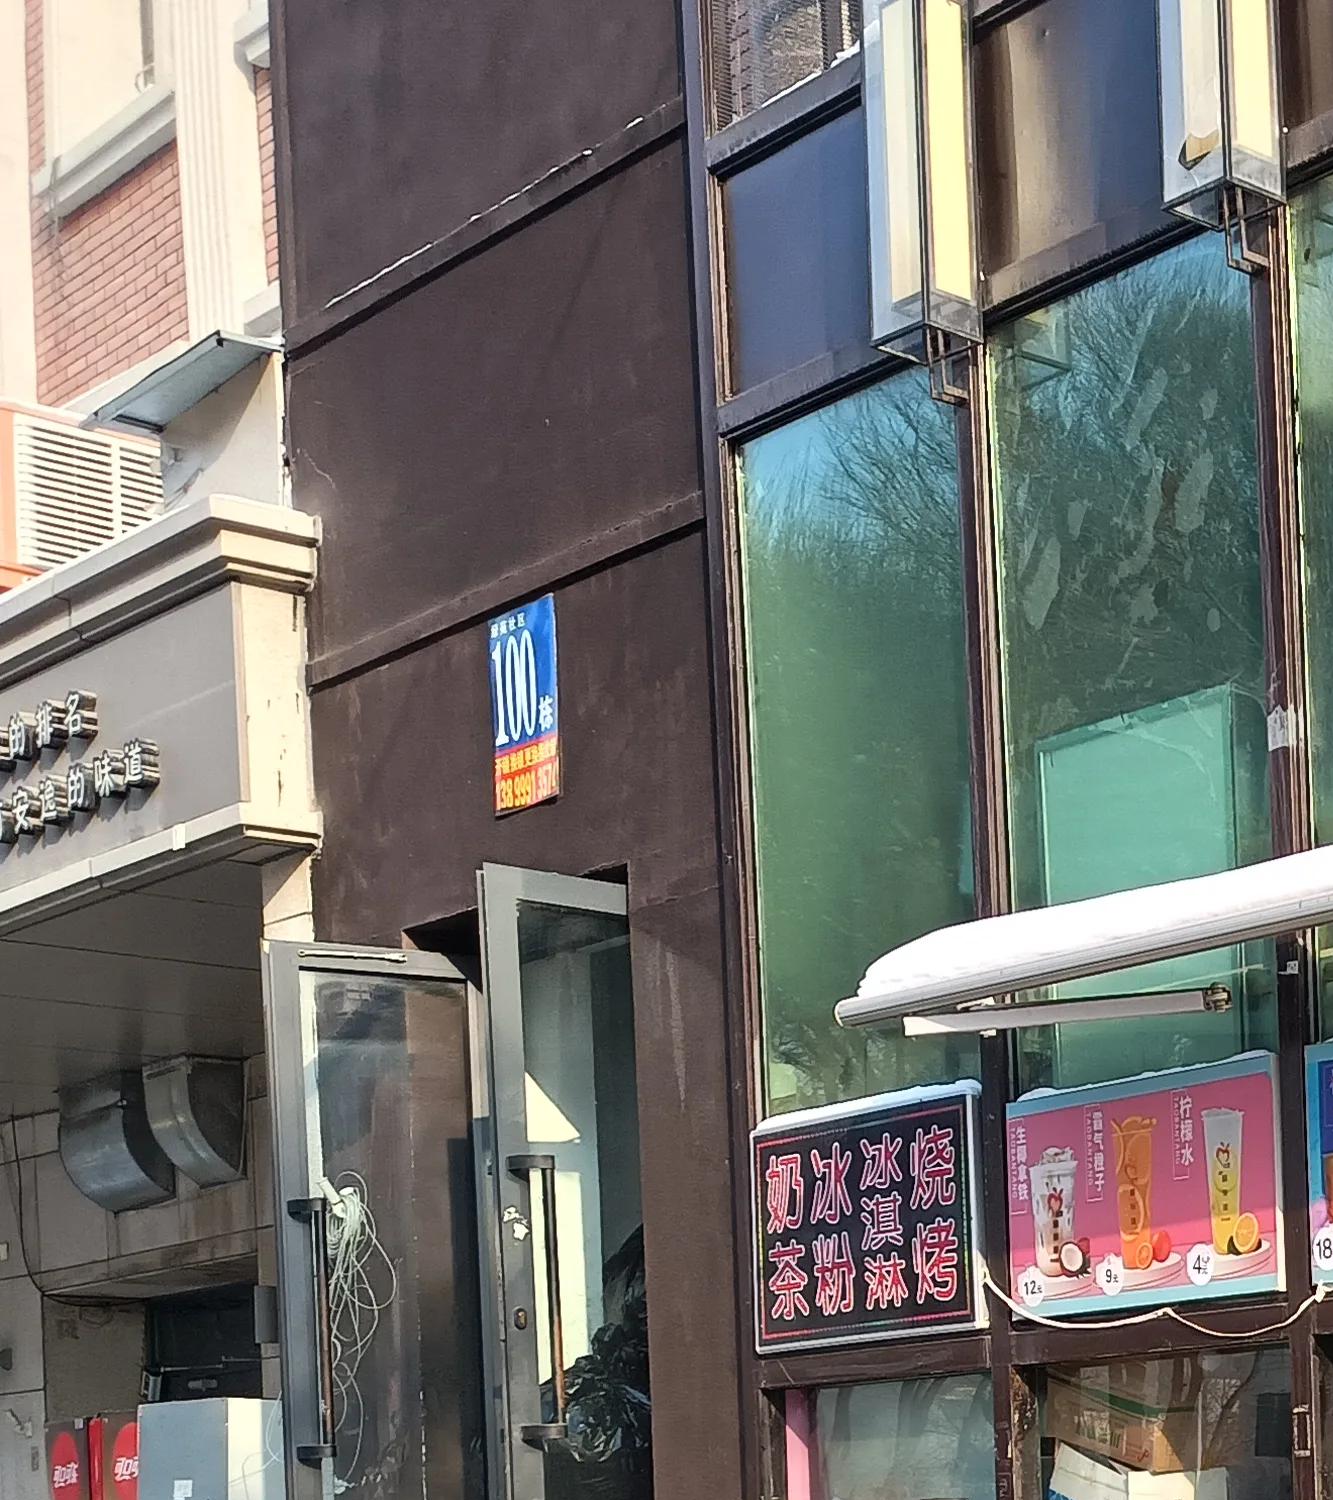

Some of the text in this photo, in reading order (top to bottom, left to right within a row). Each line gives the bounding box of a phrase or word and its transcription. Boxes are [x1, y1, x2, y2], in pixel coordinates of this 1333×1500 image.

[490, 629, 554, 746] 100 栋
[0, 740, 145, 840] 安逸的味道
[1179, 1095, 1194, 1167] 柠檬水
[766, 1154, 809, 1319] 奶茶
[810, 1142, 856, 1316] 冰粉
[860, 1133, 908, 1310] 冰淇淋
[910, 1125, 958, 1303] 烧烤
